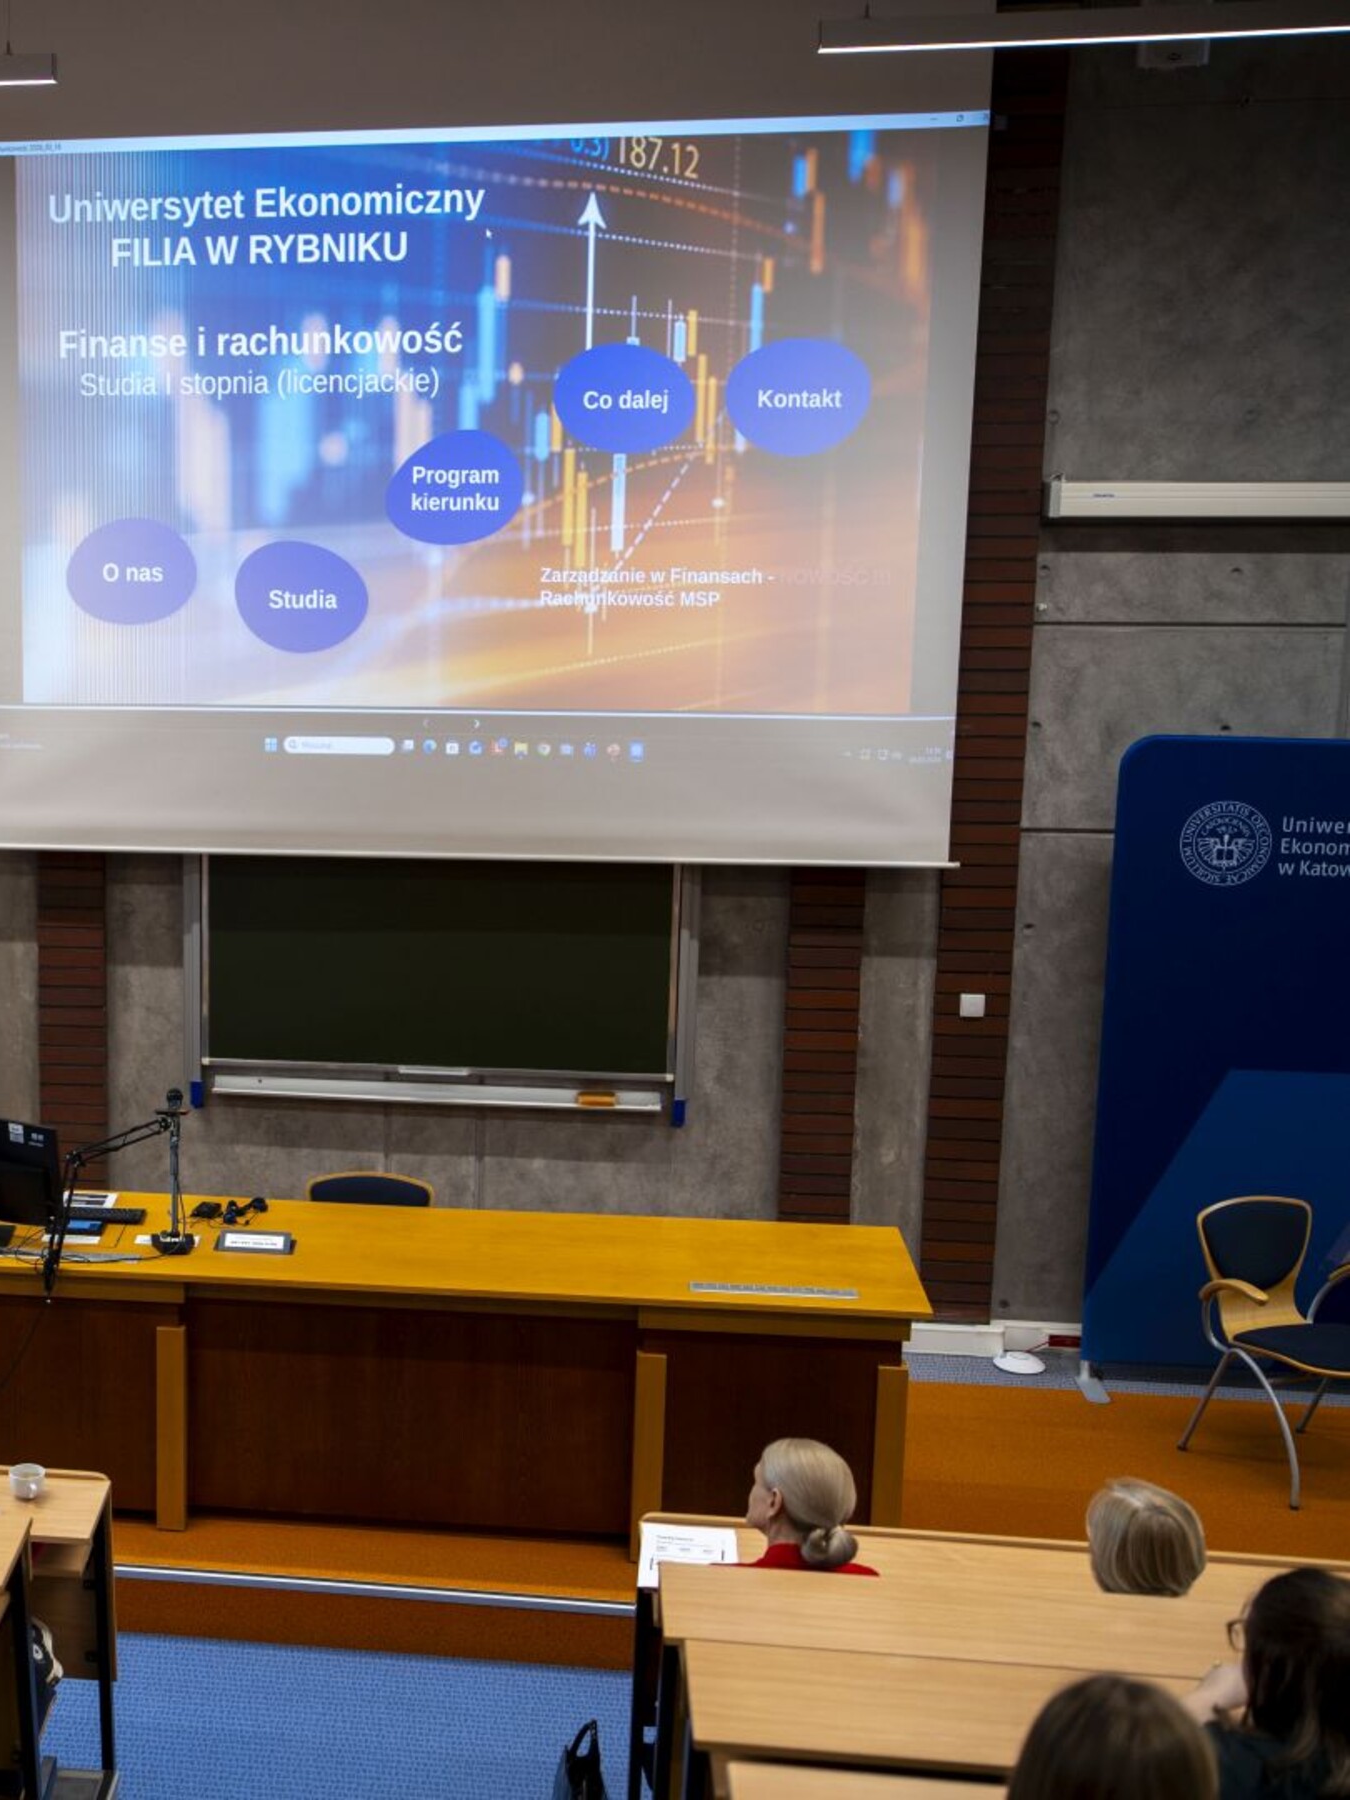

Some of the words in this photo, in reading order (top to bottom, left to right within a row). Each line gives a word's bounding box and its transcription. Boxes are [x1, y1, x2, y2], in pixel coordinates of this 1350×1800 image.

[49, 189, 245, 227] Uniwersytet
[255, 184, 485, 221] Ekonomiczny
[111, 236, 196, 267] FILIA
[206, 235, 240, 265] W
[249, 231, 408, 264] RYBNIKU
[59, 327, 187, 359] Finanse
[198, 326, 206, 357] i
[217, 321, 463, 356] rachunkowość
[80, 370, 156, 397] Studia
[180, 371, 269, 400] stopnia
[277, 366, 440, 400] (licencjackie)
[583, 390, 613, 410] Co
[619, 389, 668, 414] dalej
[757, 388, 842, 409] Kontakt
[412, 466, 499, 489] Program
[411, 493, 499, 511] kierunku
[103, 564, 119, 582] O
[126, 567, 164, 582] nas
[540, 568, 645, 585] Zarządzanie
[650, 571, 665, 582] w
[670, 568, 762, 583] Finansach
[268, 590, 337, 609] Studia
[540, 590, 674, 606] Rachunkowość
[680, 592, 720, 606] MSP
[1278, 862, 1295, 876] w
